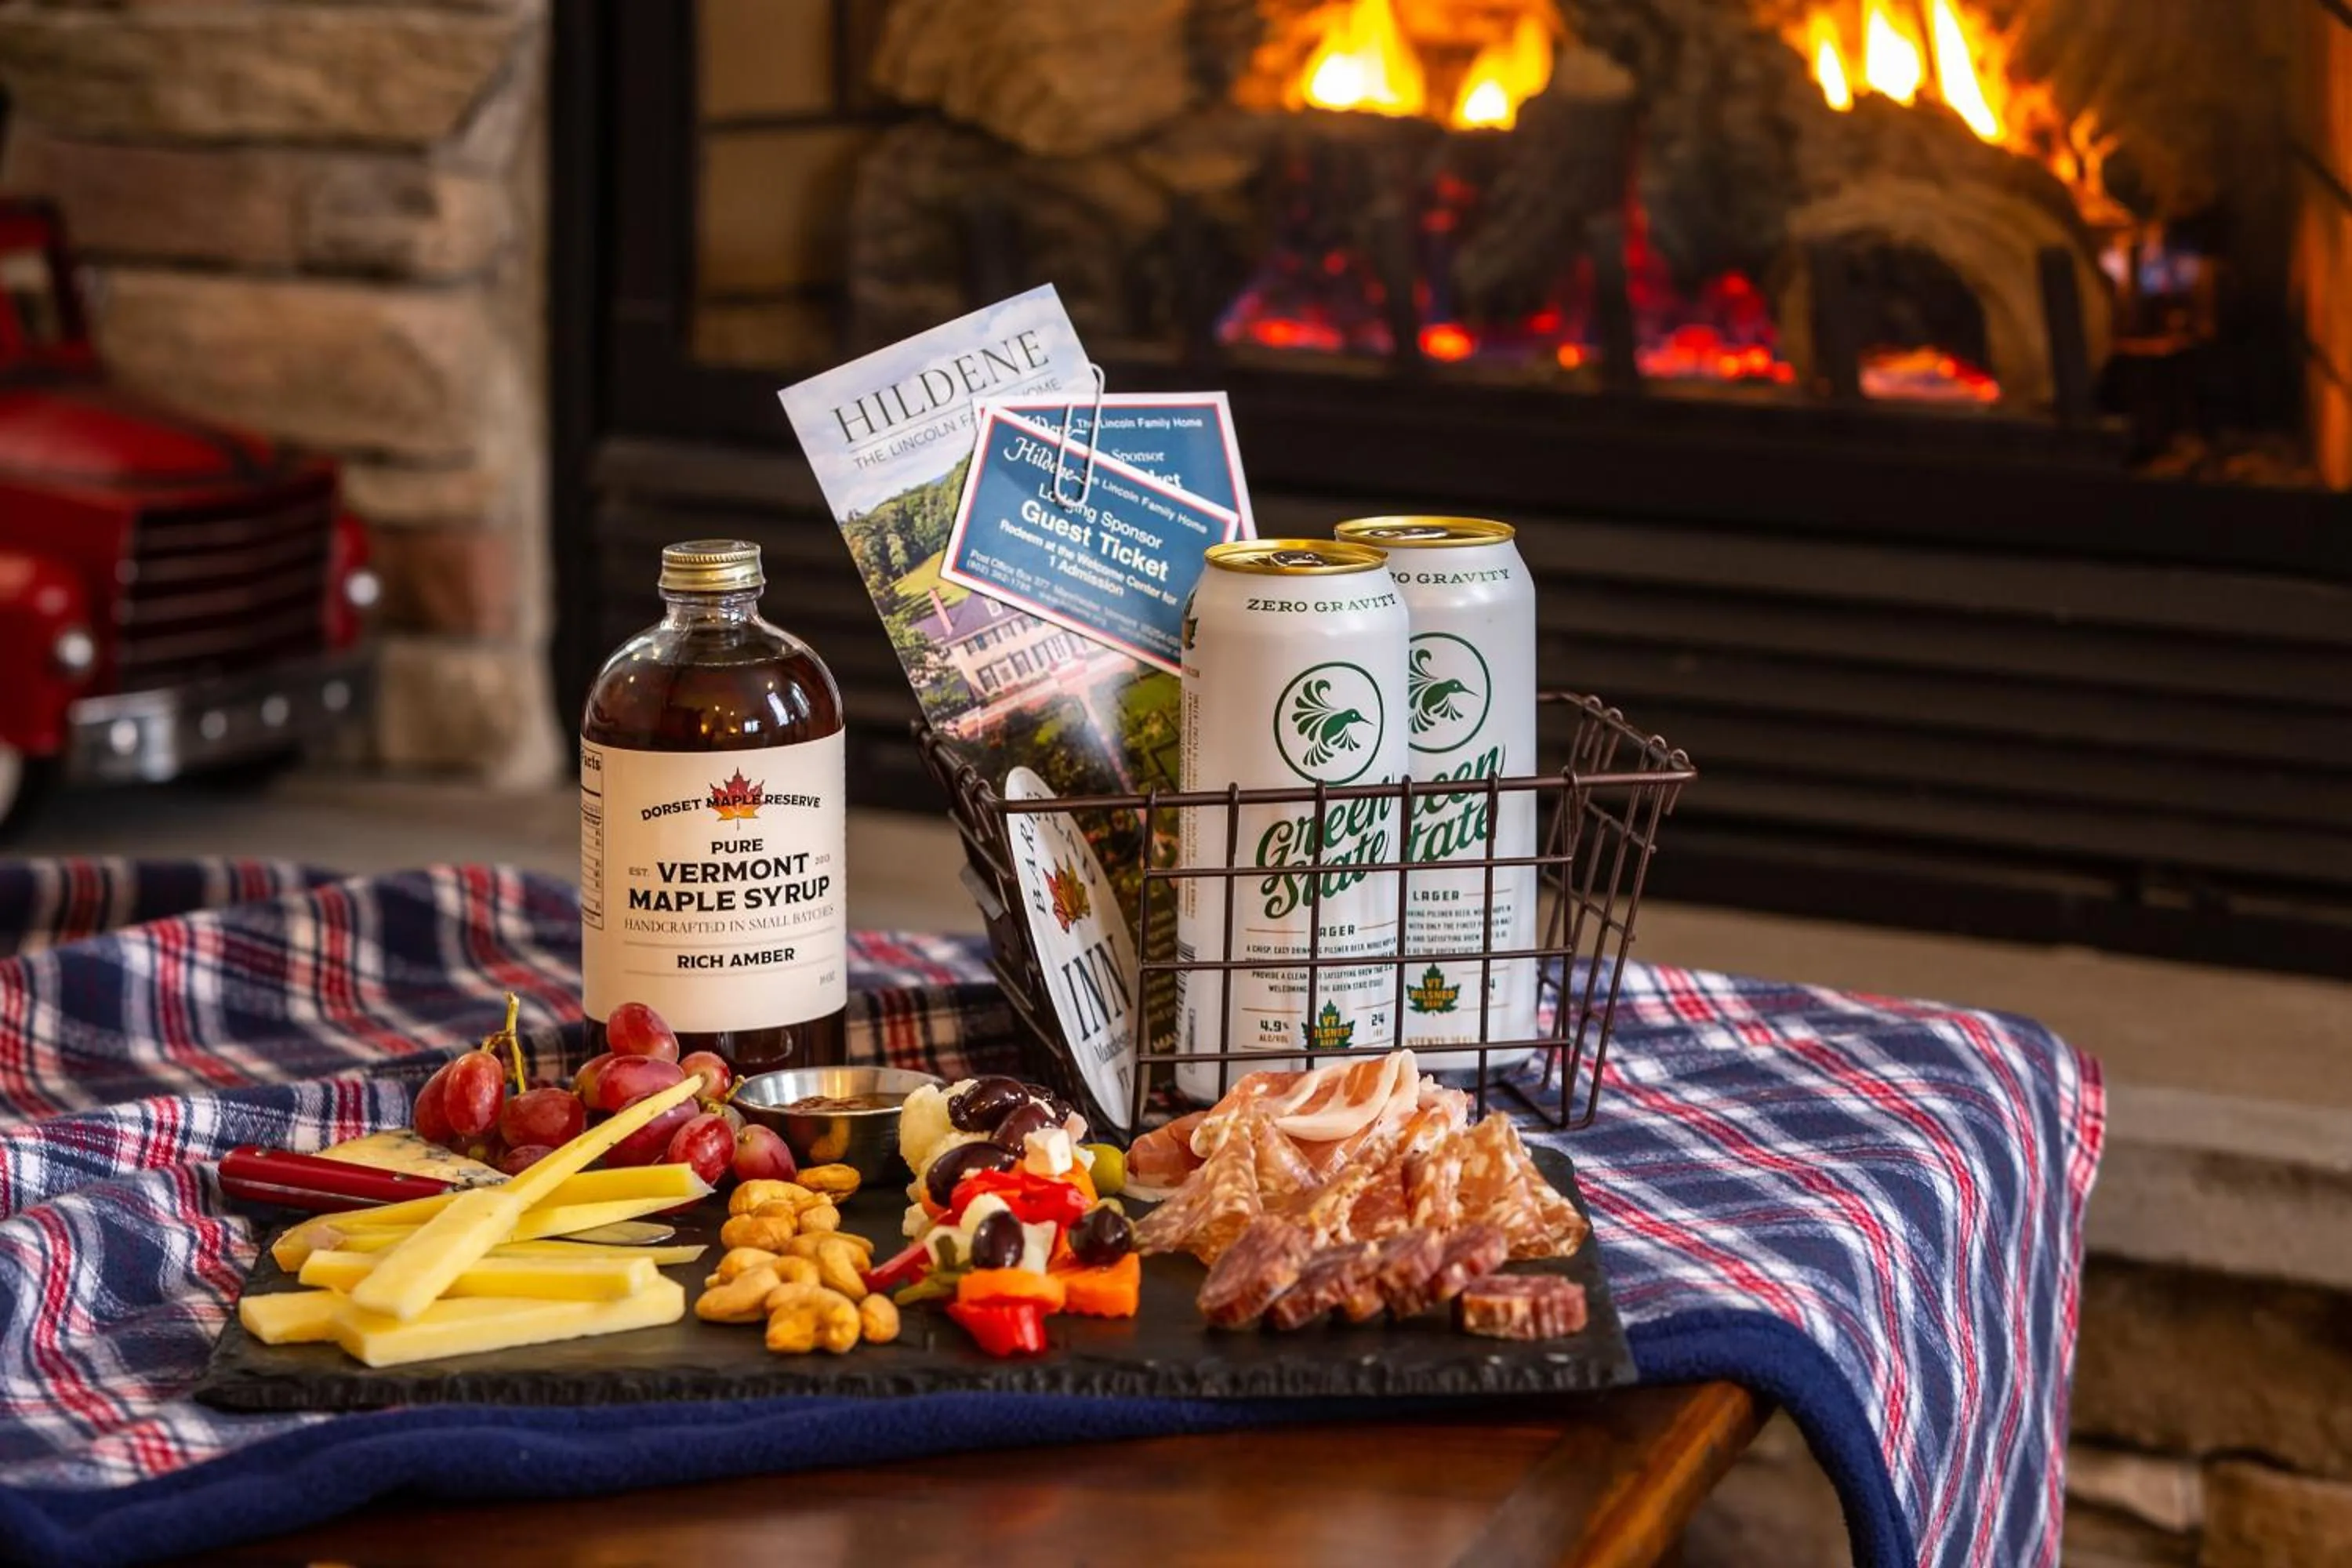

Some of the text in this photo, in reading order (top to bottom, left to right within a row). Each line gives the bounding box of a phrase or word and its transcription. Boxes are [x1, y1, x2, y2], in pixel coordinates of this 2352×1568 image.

[831, 330, 1049, 444] HILDENE
[1099, 417, 1135, 430] Lincoln
[1138, 417, 1171, 430] Family
[1173, 417, 1203, 428] Home
[854, 450, 886, 470] THE
[891, 420, 956, 457] LINCOLN
[1039, 482, 1164, 550] Loing Sponsor
[1102, 478, 1139, 504] Lincoln
[1142, 496, 1176, 521] Family
[1178, 514, 1208, 534] Home
[999, 518, 1045, 548] Redeem
[1058, 541, 1076, 561] the
[1076, 552, 1126, 583] Welcome
[1126, 576, 1161, 598] Center
[1021, 499, 1170, 583] Guest Ticket
[1049, 555, 1124, 597] 1 Admission
[1416, 568, 1511, 585] GRAVITY
[1247, 593, 1397, 613] ZERO GRAVITY
[1410, 742, 1507, 819] een
[641, 793, 822, 822] DORSET MAPLE RESERVE
[710, 838, 764, 855] PURE
[1255, 772, 1396, 896] Green
[1406, 800, 1493, 864] tate
[628, 866, 651, 877] EST.
[656, 852, 810, 884] VERMONT
[1264, 829, 1392, 920] State
[628, 875, 831, 913] MAPLE SYRUP
[1413, 890, 1460, 902] LAGER
[624, 916, 726, 934] HANDCRAFTED
[729, 920, 746, 933] IN
[748, 913, 790, 931] SMALL
[1319, 924, 1356, 938] AGER
[677, 947, 796, 970] RICH AMBER
[1061, 933, 1134, 1042] INN
